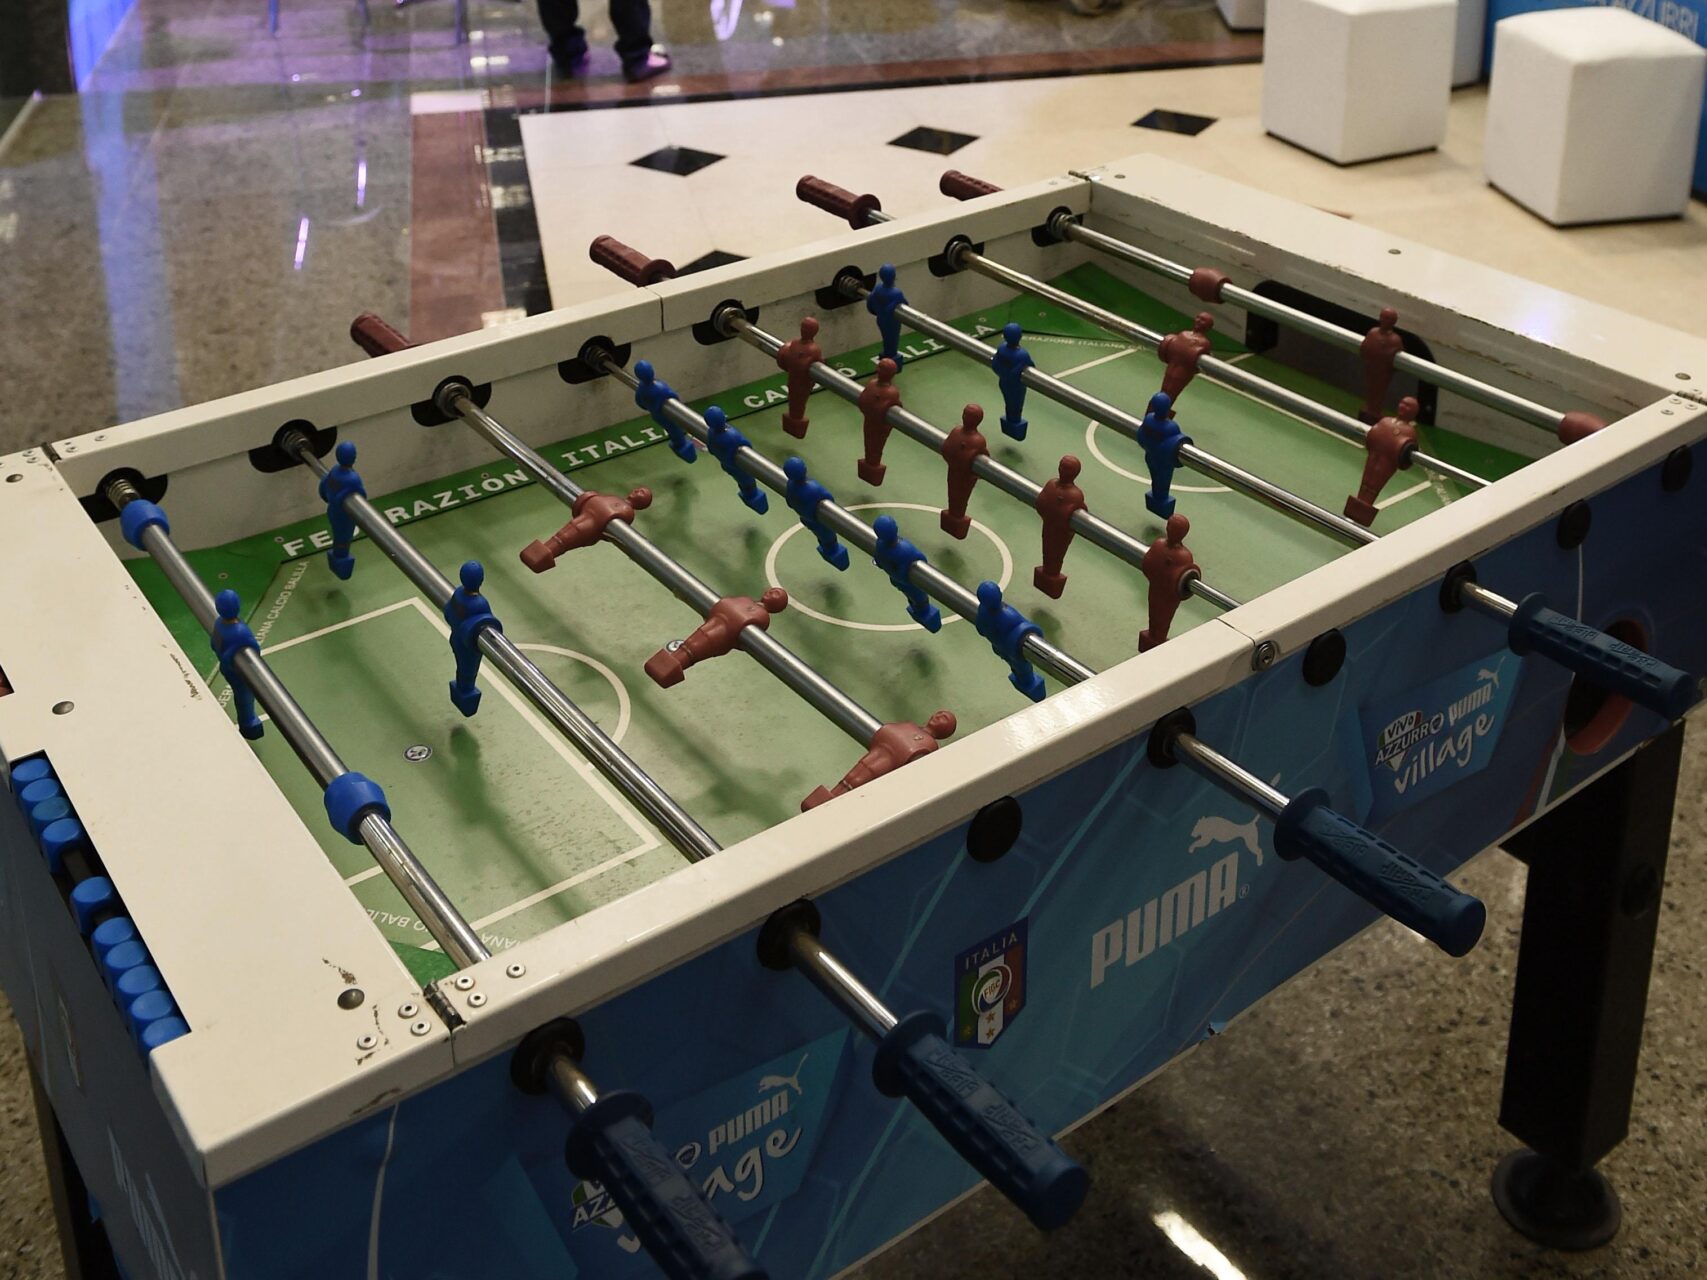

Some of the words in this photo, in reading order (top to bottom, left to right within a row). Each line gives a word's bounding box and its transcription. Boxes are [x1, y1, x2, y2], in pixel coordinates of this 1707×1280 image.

[1449, 682, 1493, 728] PUMA
[1374, 711, 1445, 767] AZZURRO
[1090, 850, 1240, 989] PUMA
[965, 932, 1018, 970] ITALIA
[708, 1089, 790, 1156] PUMA
